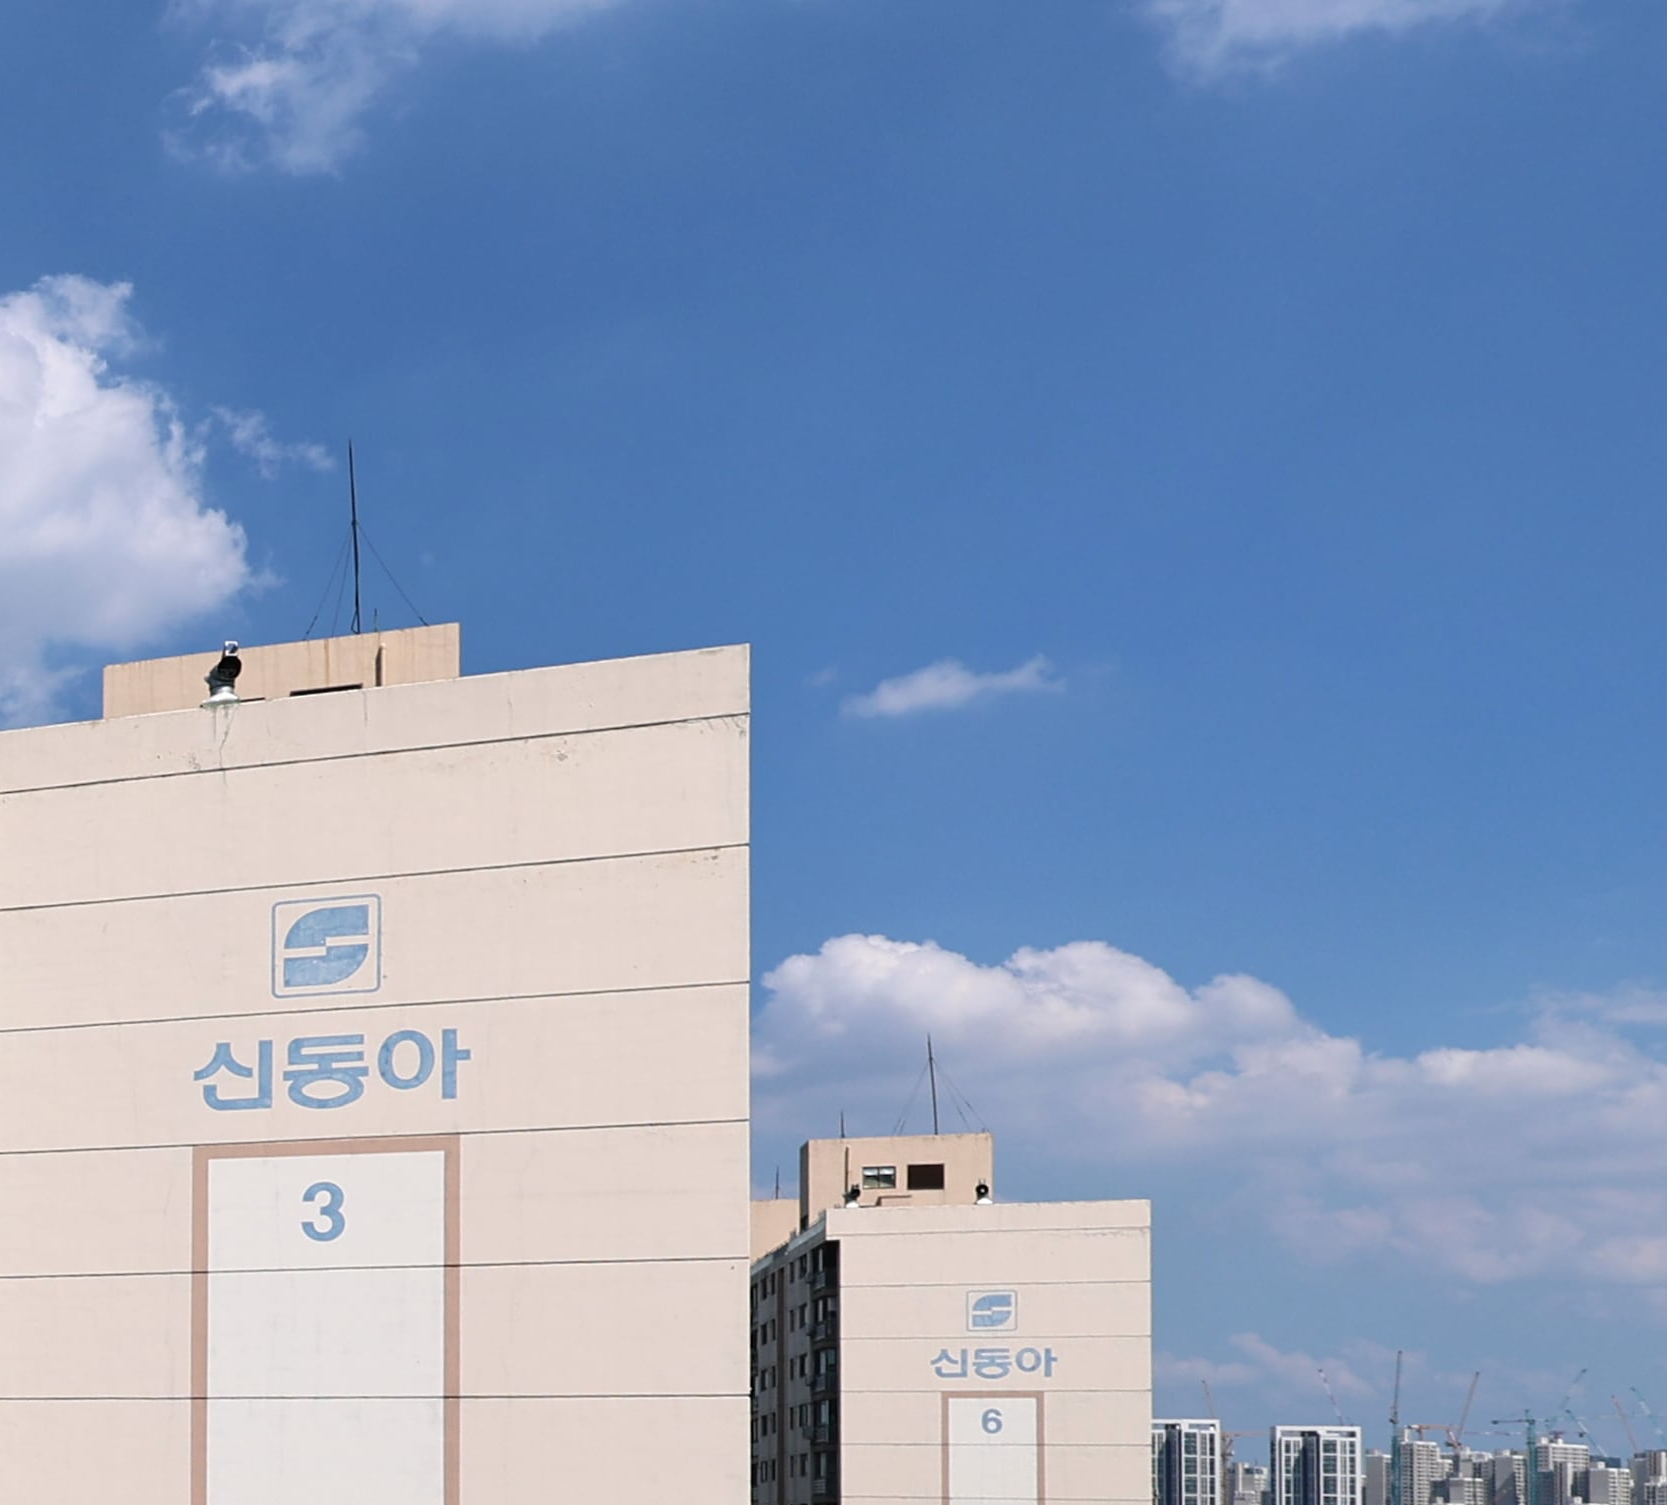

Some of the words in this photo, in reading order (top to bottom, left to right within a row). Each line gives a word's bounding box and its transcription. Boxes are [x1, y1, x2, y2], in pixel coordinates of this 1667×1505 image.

[193, 1027, 471, 1112] 신동아
[300, 1181, 346, 1242] 3
[930, 1347, 1058, 1379] 신동아
[980, 1408, 1003, 1435] 6
